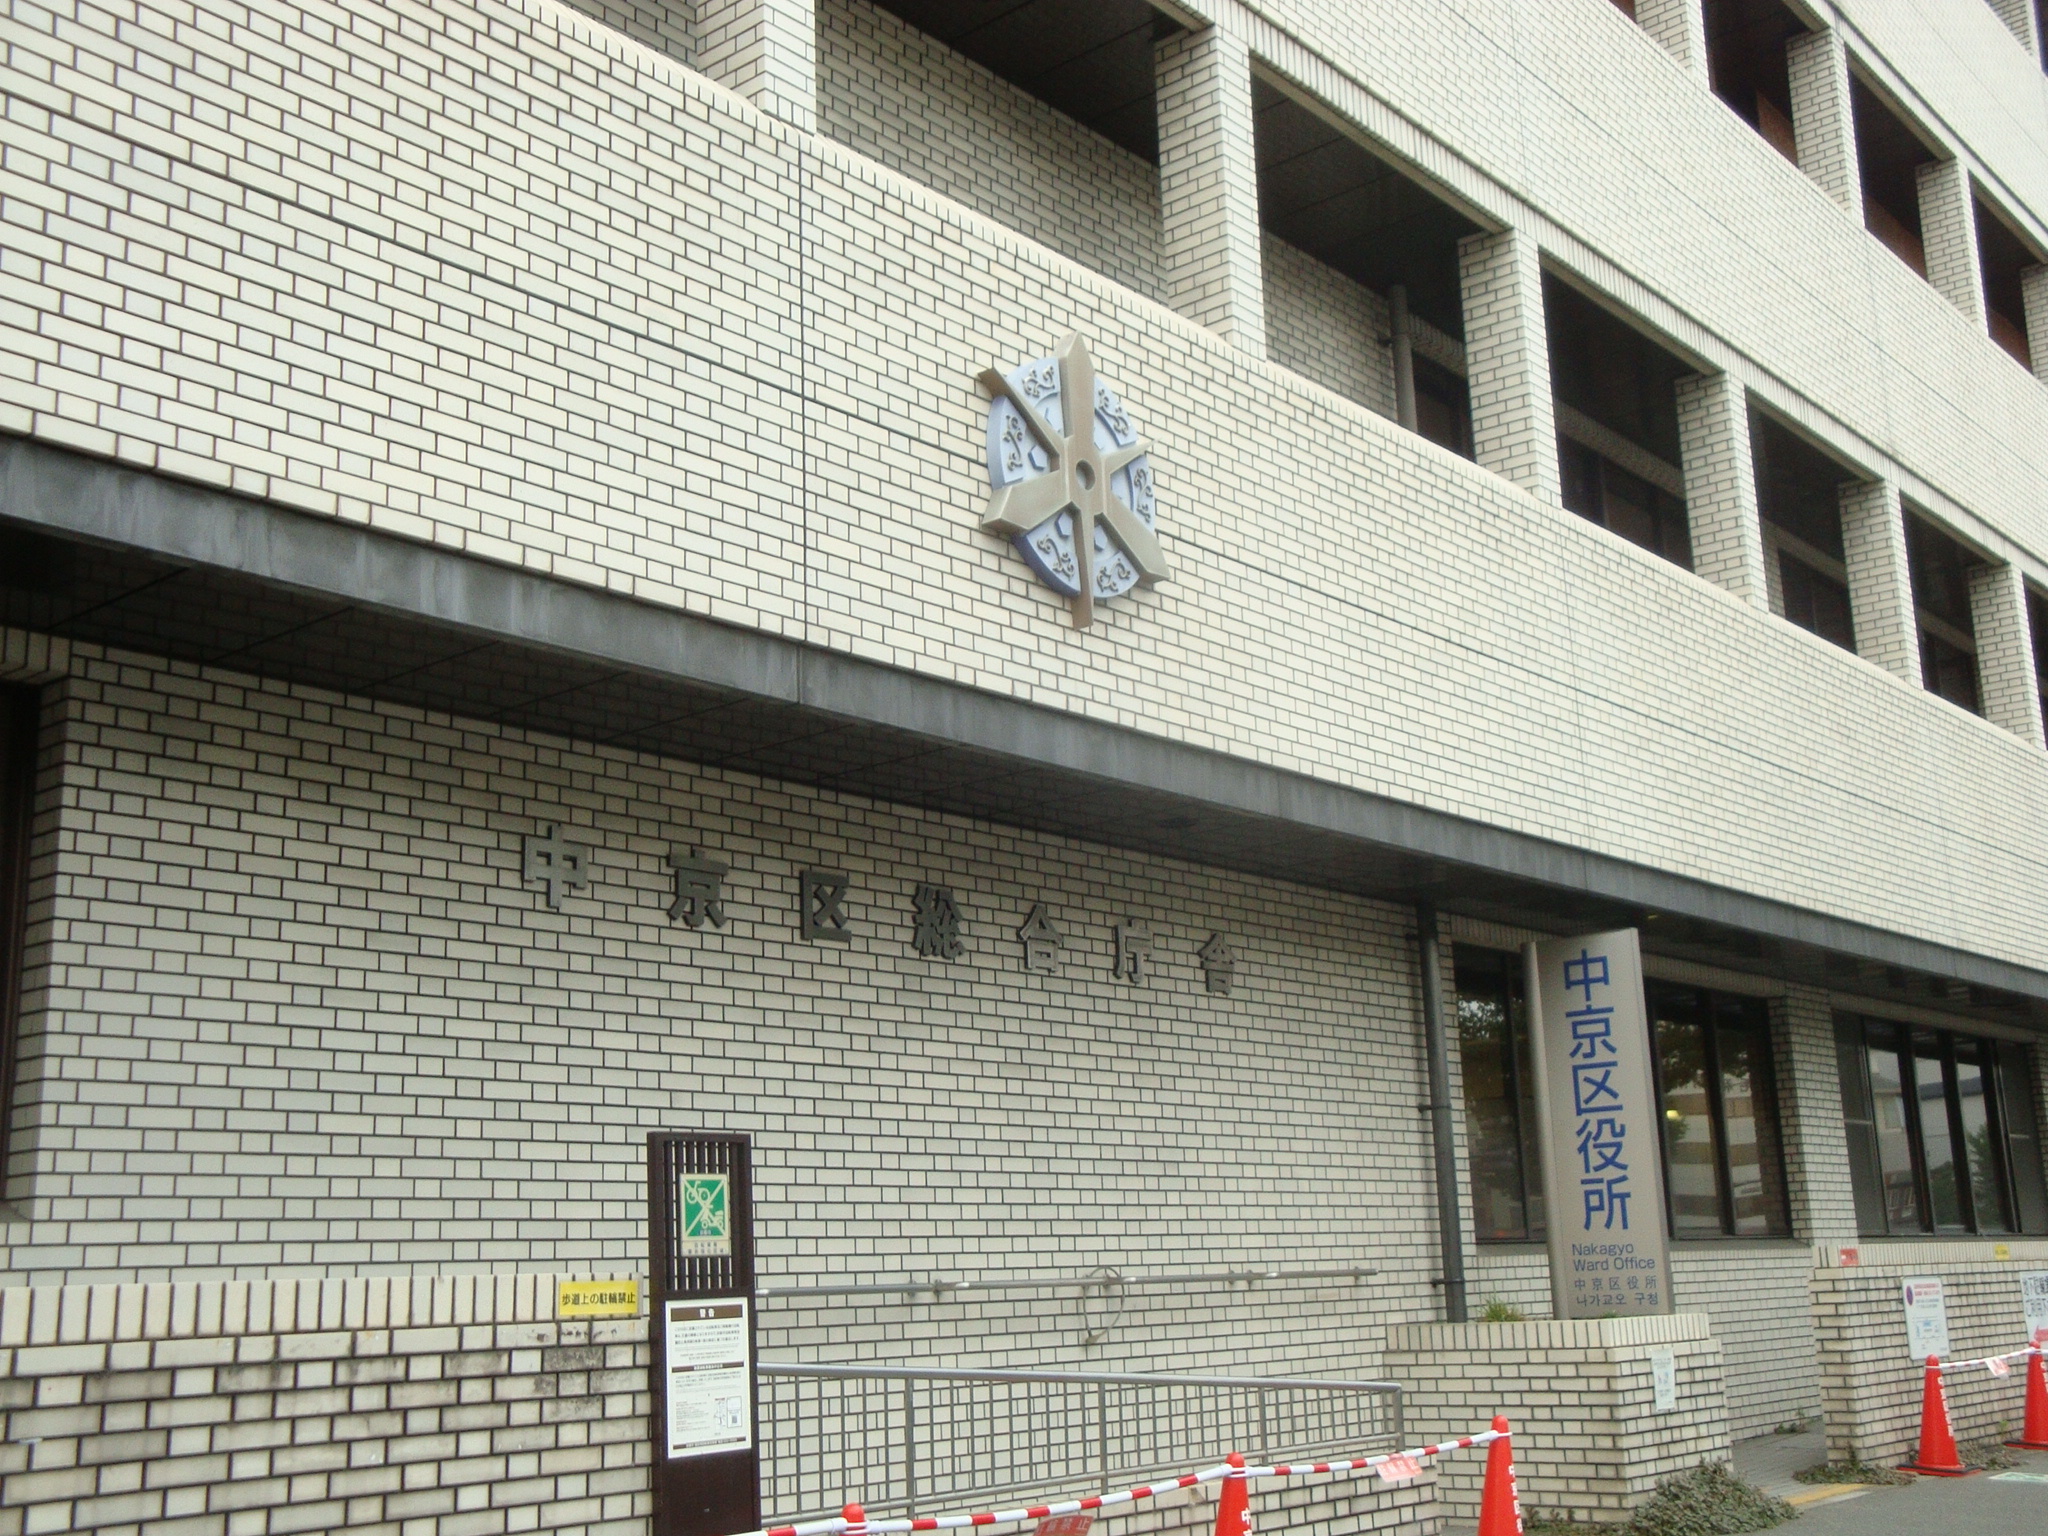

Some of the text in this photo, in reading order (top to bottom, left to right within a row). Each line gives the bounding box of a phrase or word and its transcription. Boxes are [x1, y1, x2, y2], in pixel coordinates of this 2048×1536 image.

[523, 823, 1238, 994] 中京区総合庁舎
[1562, 947, 1632, 1232] 中京区役所
[1571, 1243, 1634, 1257] Nakagyo
[1573, 1257, 1656, 1271] Ward Office
[1574, 1275, 1657, 1291] 中京区役所
[561, 1291, 636, 1306] 歩道上の駐輪禁止
[1576, 1292, 1659, 1307] 나가교오 구청
